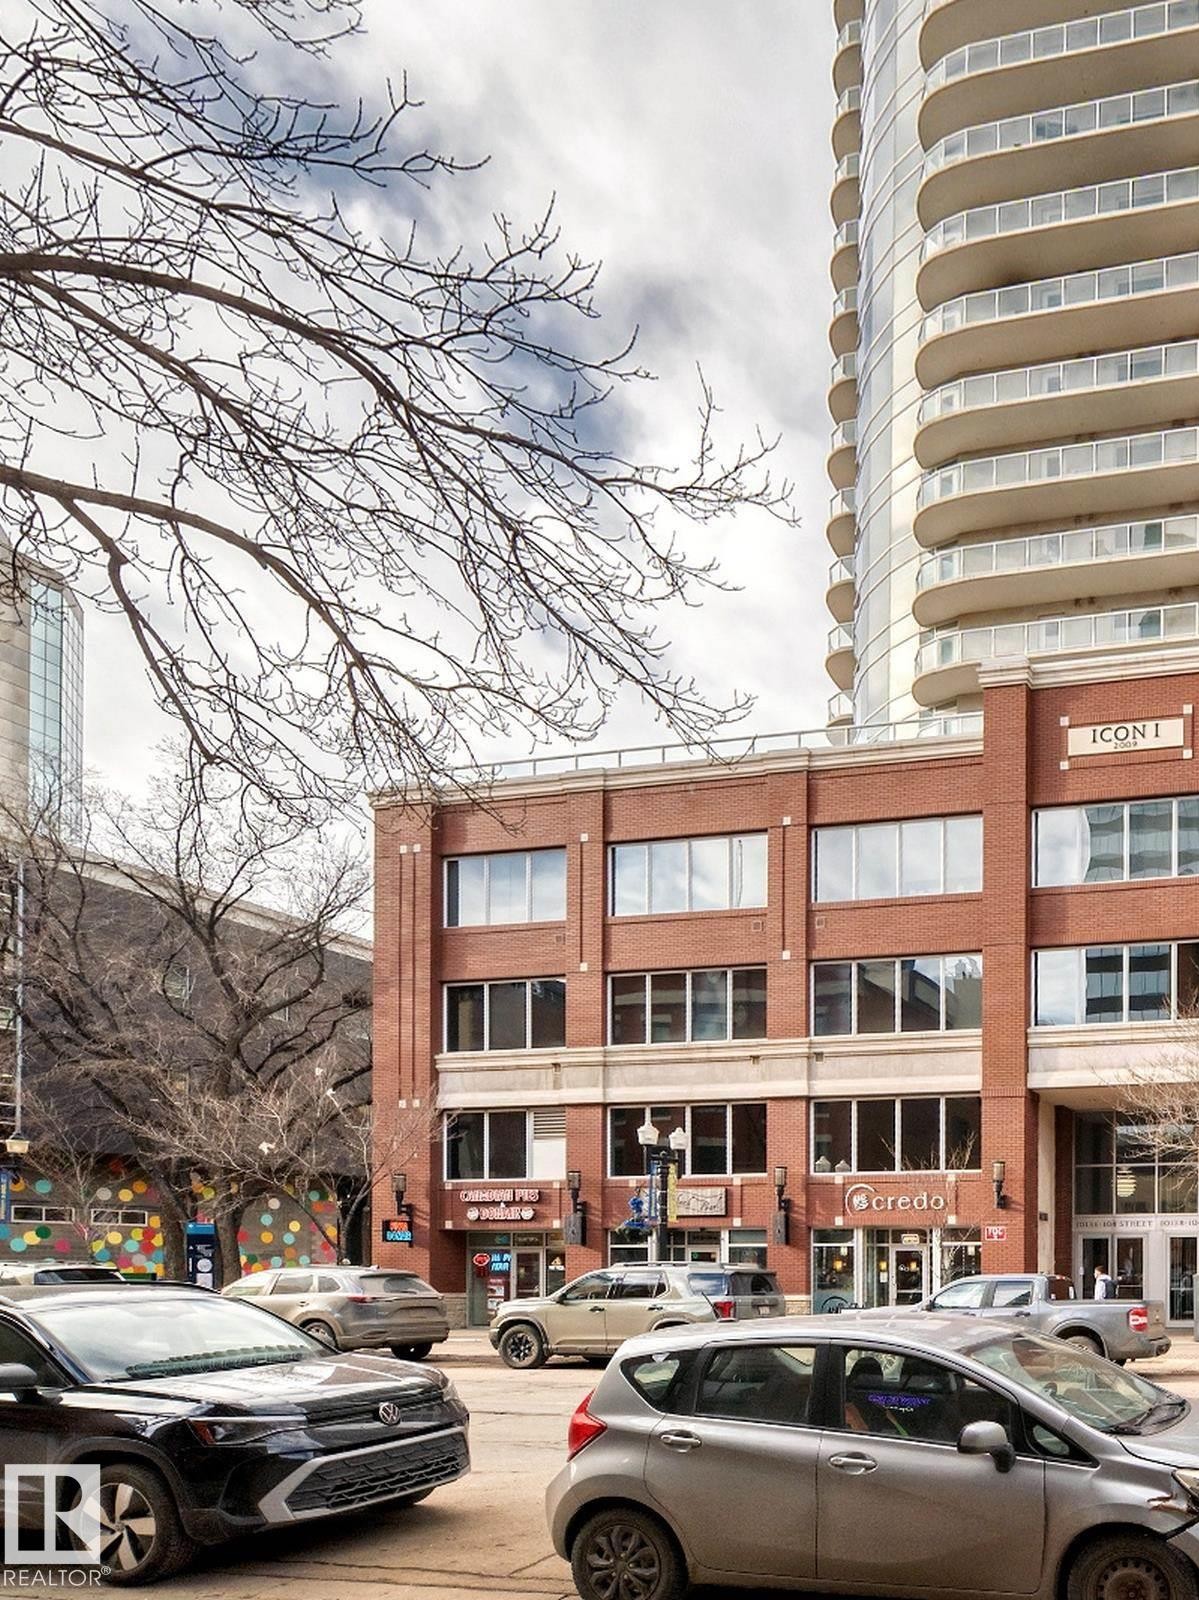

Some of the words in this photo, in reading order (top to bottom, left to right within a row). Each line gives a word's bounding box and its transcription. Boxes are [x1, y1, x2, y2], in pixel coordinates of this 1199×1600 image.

[1091, 724, 1147, 743] ICON
[1154, 723, 1160, 738] I
[1113, 741, 1138, 749] 2009
[872, 1191, 944, 1211] credo
